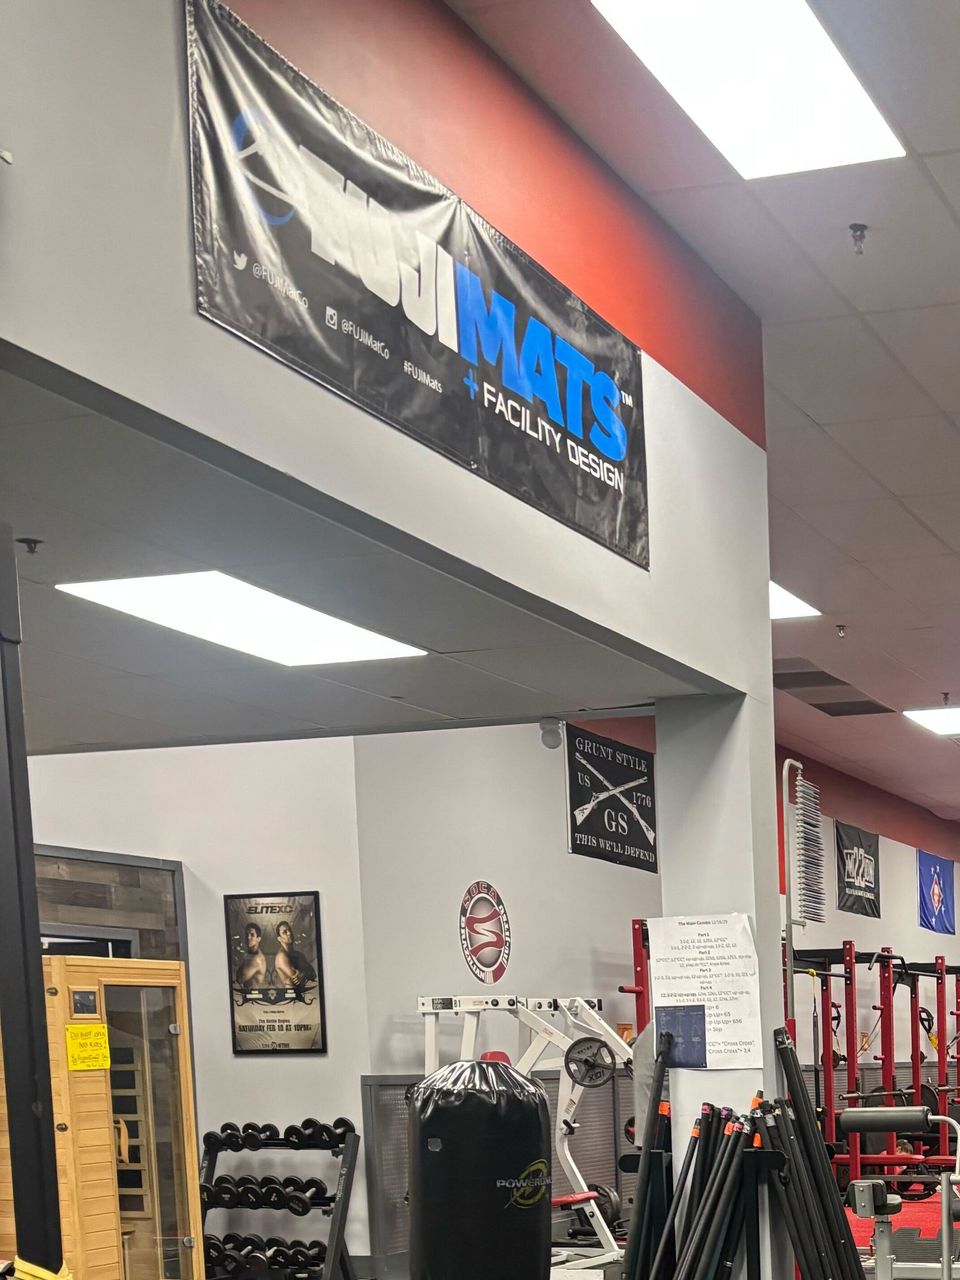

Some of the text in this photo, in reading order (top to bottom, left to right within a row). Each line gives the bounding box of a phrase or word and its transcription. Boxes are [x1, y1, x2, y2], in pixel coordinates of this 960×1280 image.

[341, 319, 390, 360] @FUJIMatCo
[403, 360, 443, 393] #FUJIMats
[483, 381, 562, 454] FACILITY
[566, 438, 625, 495] DESIGN
[575, 737, 648, 773] GRUNT STYLE
[577, 771, 591, 788] US
[632, 791, 652, 808] 1776
[604, 808, 629, 836] GS
[574, 833, 655, 863] THIS WE'LL DEFEND
[463, 881, 498, 909] SOCA
[246, 904, 294, 915] ELITEXC
[238, 1024, 265, 1033] SATURDAY
[266, 1024, 275, 1032] FEB
